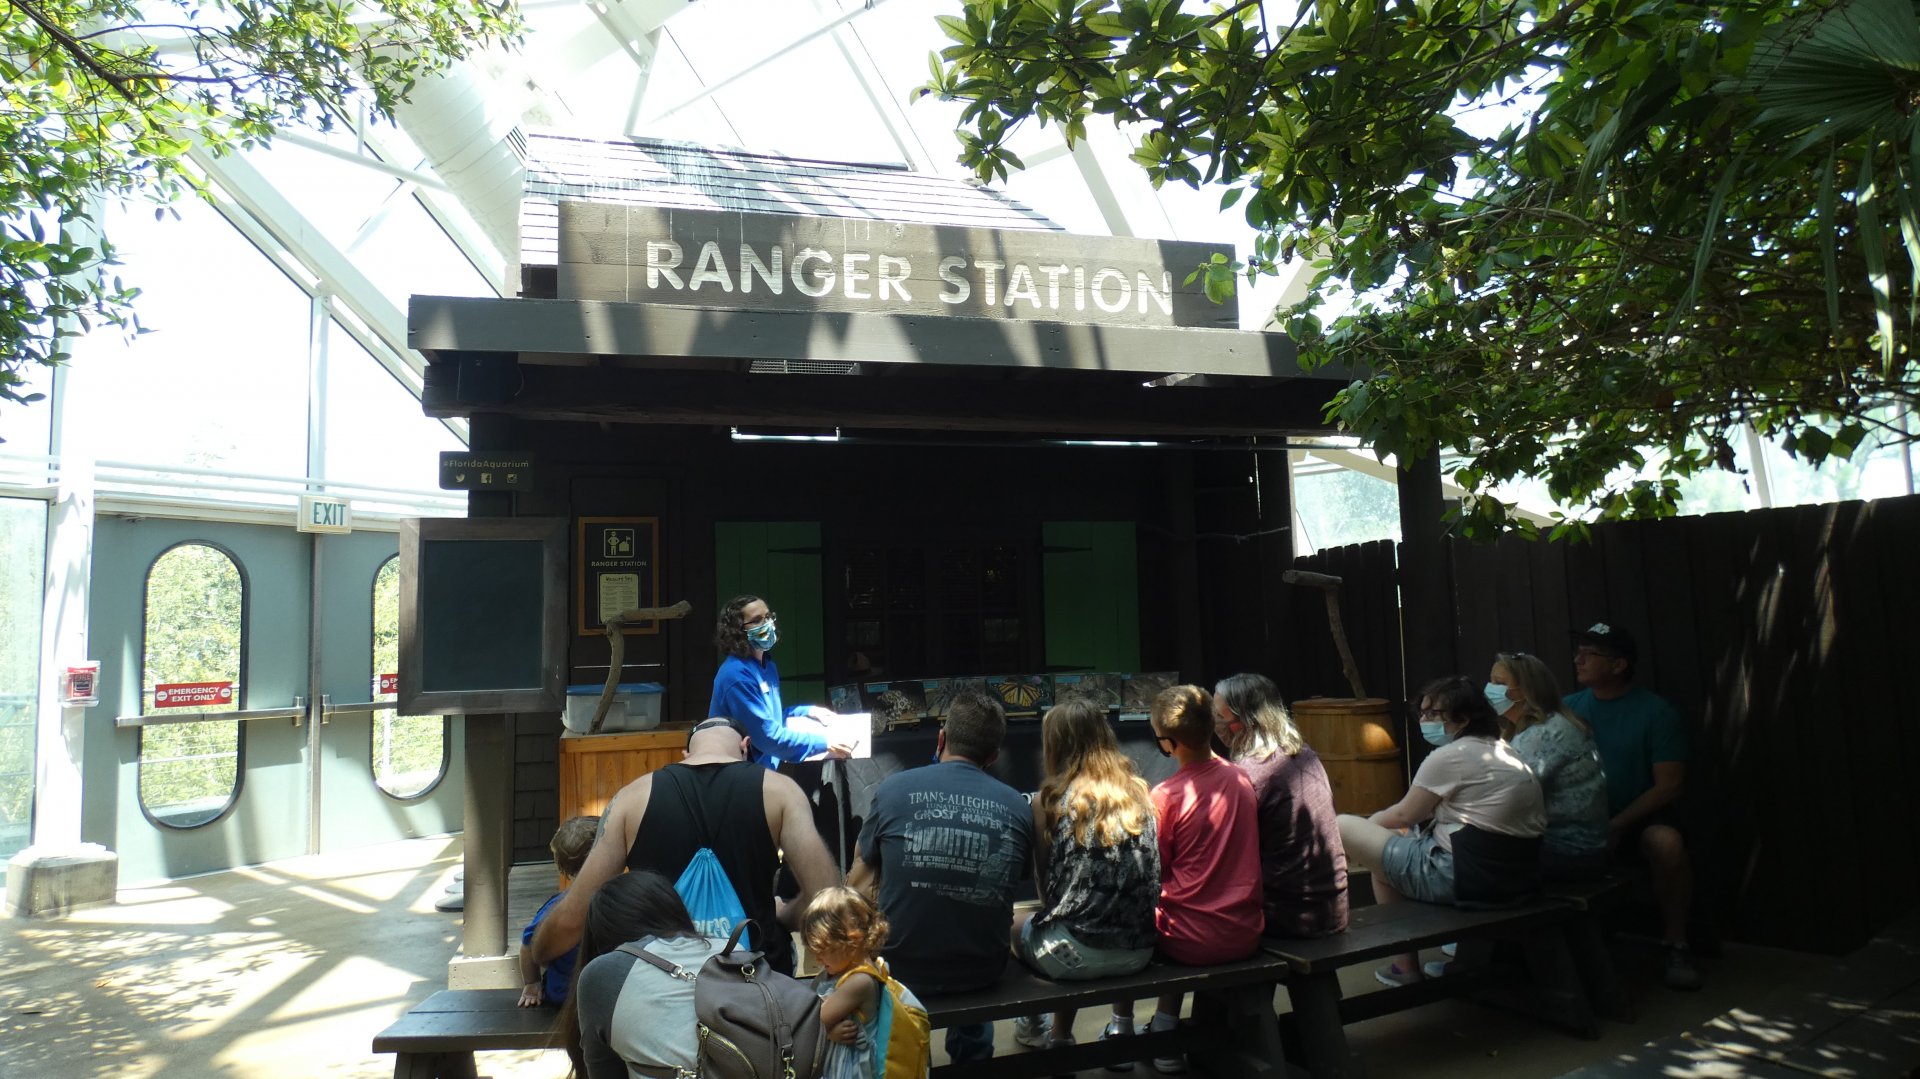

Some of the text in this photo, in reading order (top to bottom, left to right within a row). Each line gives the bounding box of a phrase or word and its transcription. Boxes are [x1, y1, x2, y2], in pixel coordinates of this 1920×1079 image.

[646, 240, 1173, 315] RANGER STATION
[443, 460, 529, 468] #FloridaAquarium
[313, 502, 346, 526] EXIT
[168, 686, 220, 695] EMERGENCY
[914, 809, 957, 820] GHOST
[926, 803, 993, 818] LUNATIC ASYLUM
